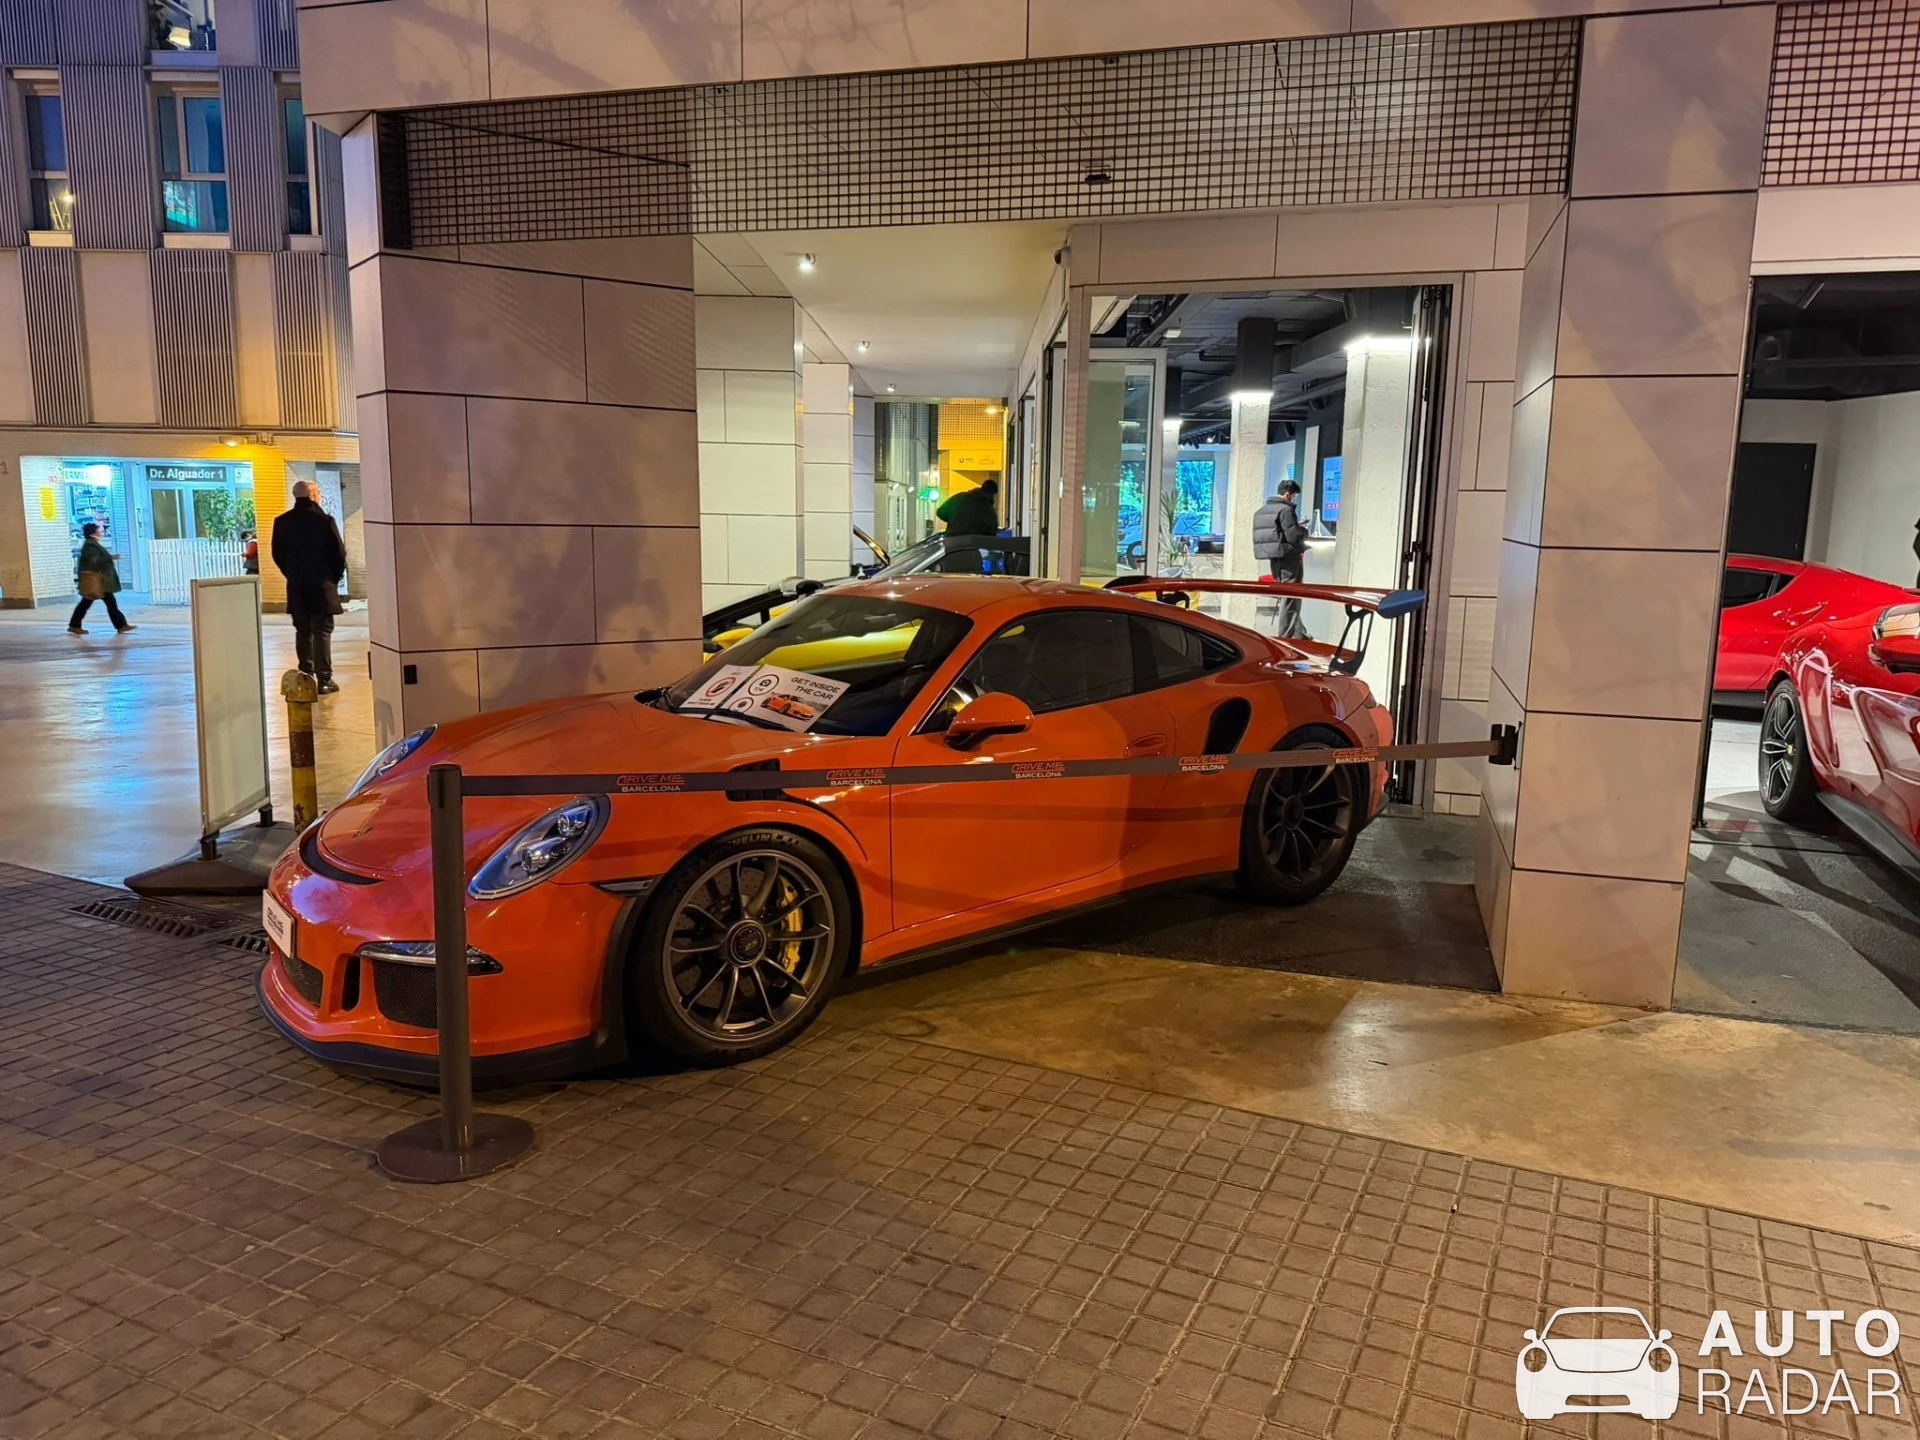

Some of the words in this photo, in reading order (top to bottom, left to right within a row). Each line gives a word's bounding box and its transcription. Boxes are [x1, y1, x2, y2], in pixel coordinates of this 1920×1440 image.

[149, 468, 165, 478] Dr.
[166, 468, 216, 481] Alguader
[218, 470, 224, 479] 1
[791, 677, 810, 685] GET
[809, 681, 841, 693] INSIDE
[796, 686, 814, 695] THE
[813, 691, 834, 700] CAR
